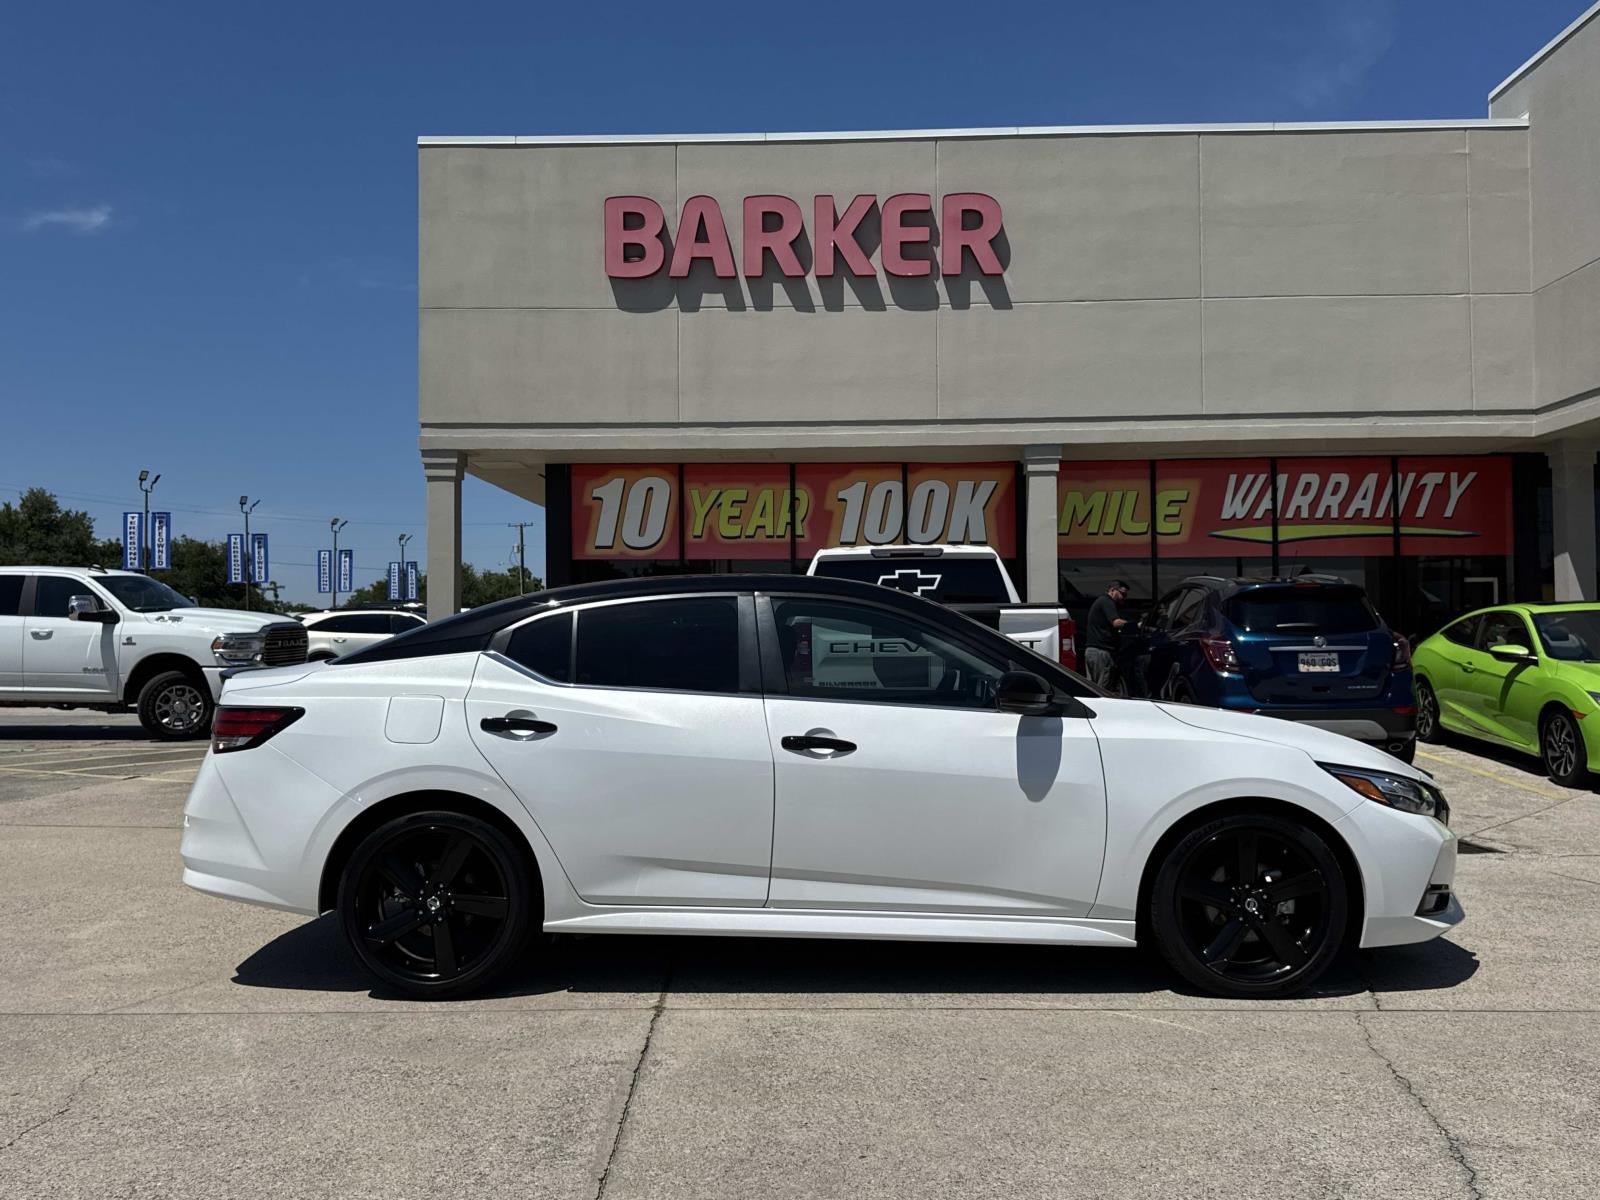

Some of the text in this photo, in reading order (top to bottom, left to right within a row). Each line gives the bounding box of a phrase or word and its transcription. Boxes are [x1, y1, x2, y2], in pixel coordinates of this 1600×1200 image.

[604, 193, 1005, 278] BARKER
[128, 515, 137, 567] TERREBONNE
[156, 519, 165, 567] PREOWNED
[592, 472, 1478, 550] 10 YEAR 100K MILE WARRANTY
